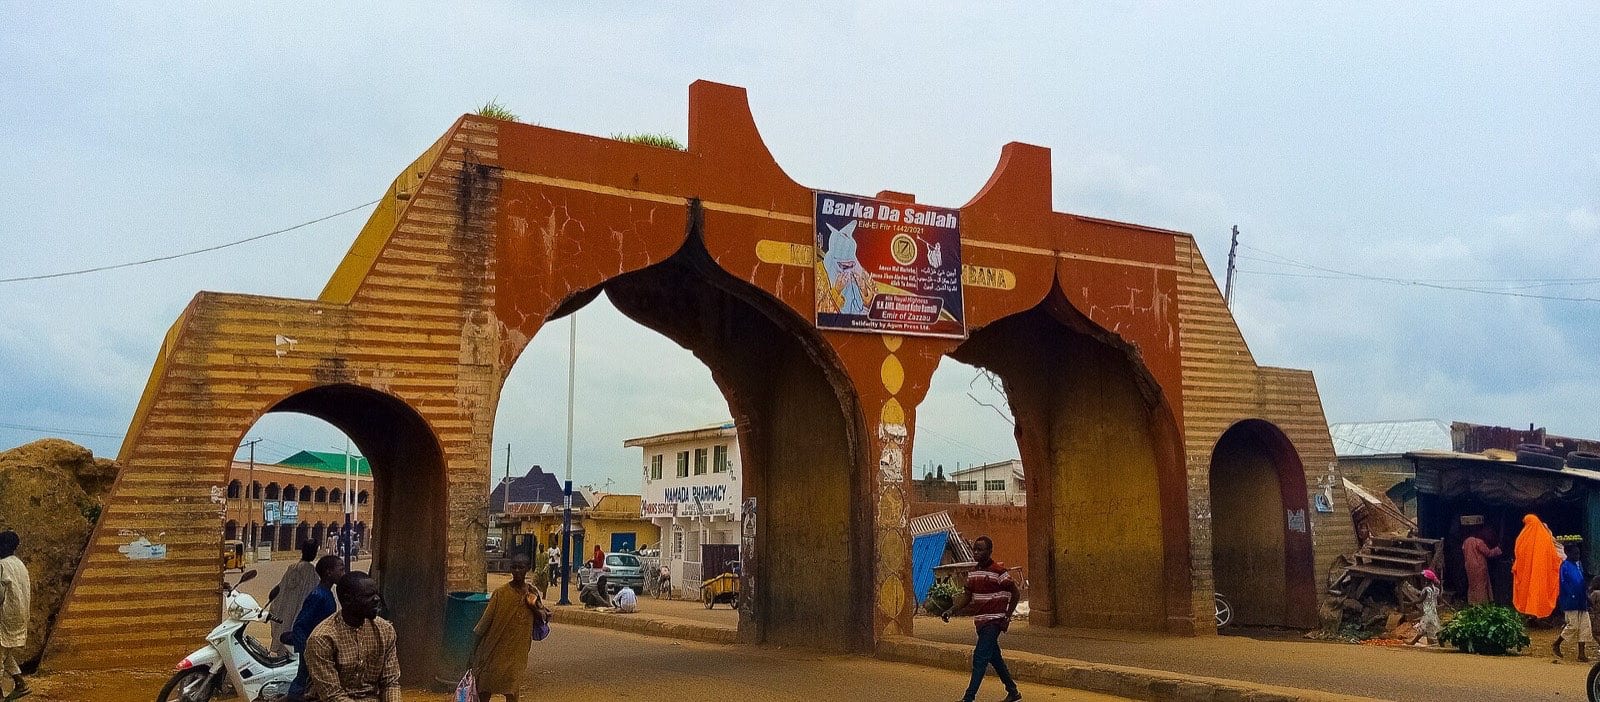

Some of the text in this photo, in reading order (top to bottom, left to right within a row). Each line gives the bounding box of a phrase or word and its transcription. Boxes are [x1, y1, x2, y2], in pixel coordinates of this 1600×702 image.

[822, 199, 957, 229] Barka Da Sallah
[858, 221, 879, 229] Eid-El
[893, 224, 924, 234] 1442/2021
[895, 303, 910, 311] Ahmed
[882, 311, 897, 319] Emir
[899, 312, 906, 320] of
[851, 320, 879, 328] Solidarity
[664, 485, 727, 503] NAMADA PHARMACY
